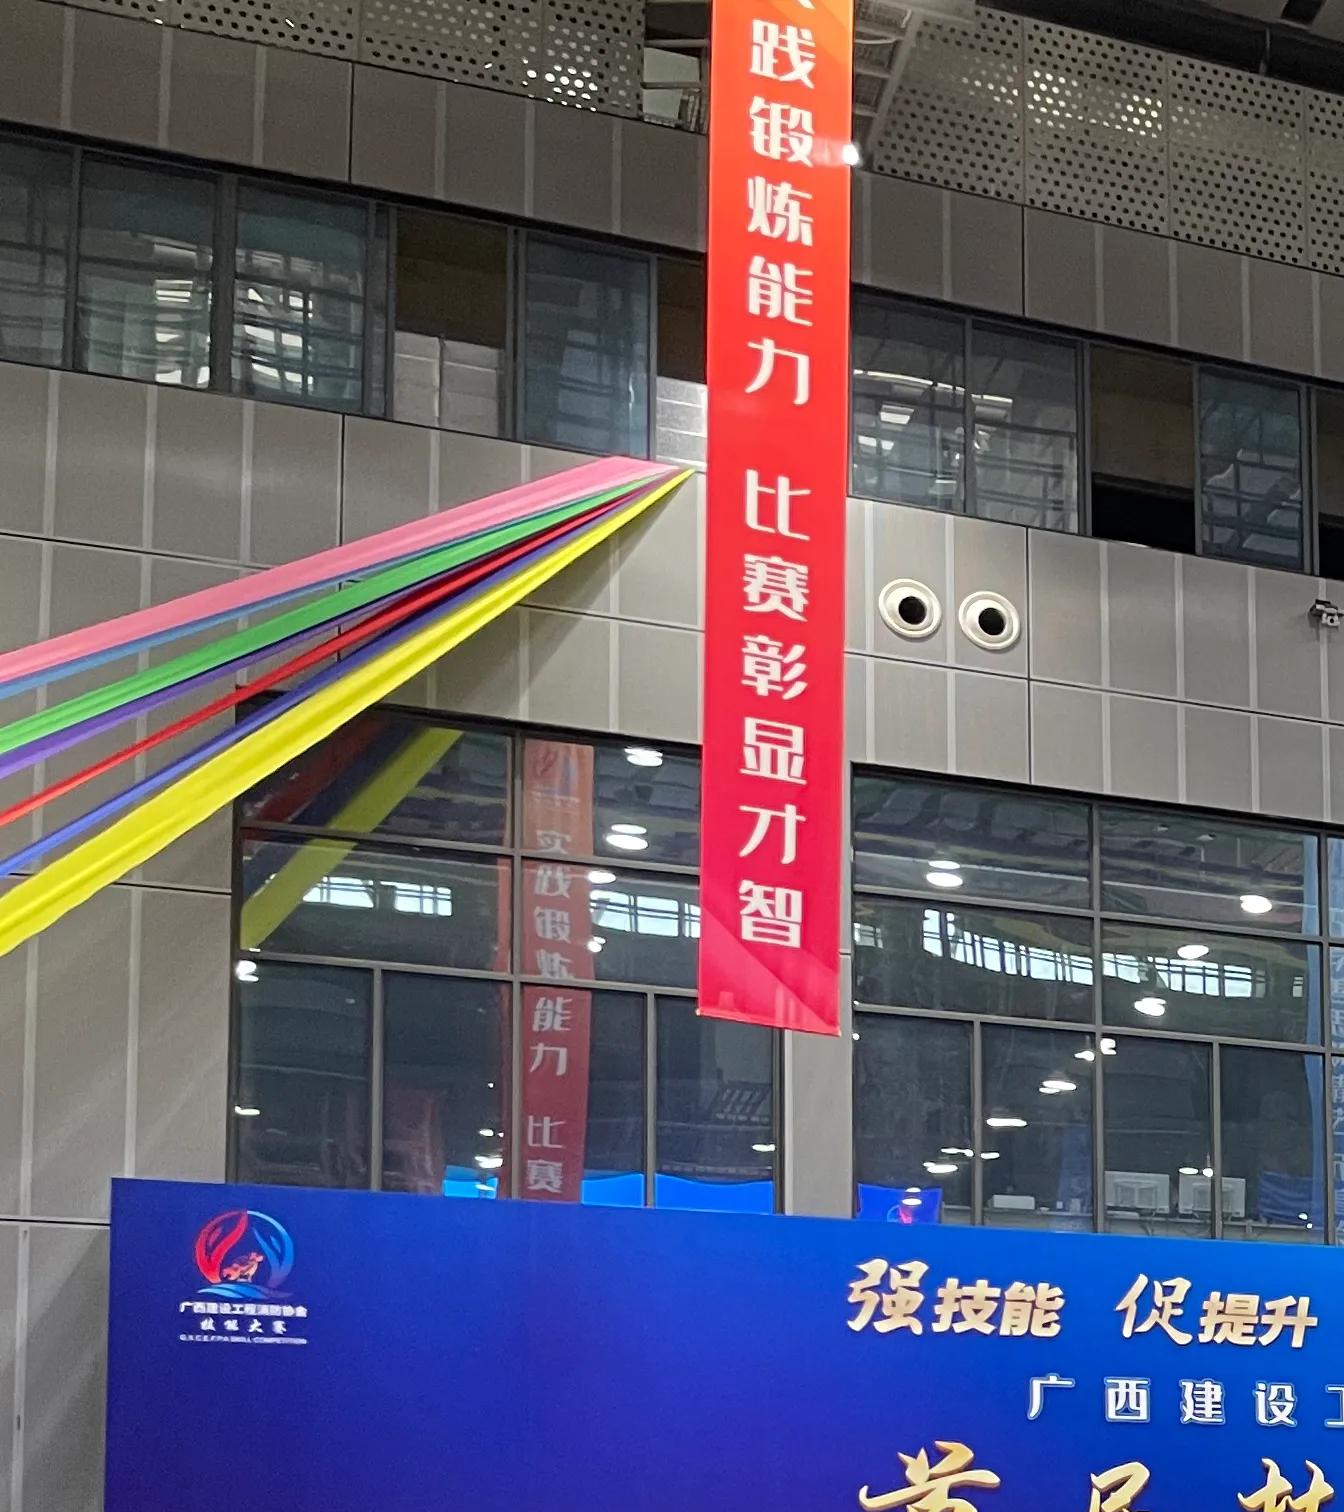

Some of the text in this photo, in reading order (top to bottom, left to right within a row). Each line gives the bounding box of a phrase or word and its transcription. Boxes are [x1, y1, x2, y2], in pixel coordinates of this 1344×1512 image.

[739, 0, 816, 949] 践锻炼能力 比赛彰显才智
[846, 1257, 1066, 1338] 强技能
[1114, 1272, 1319, 1349] 促提升
